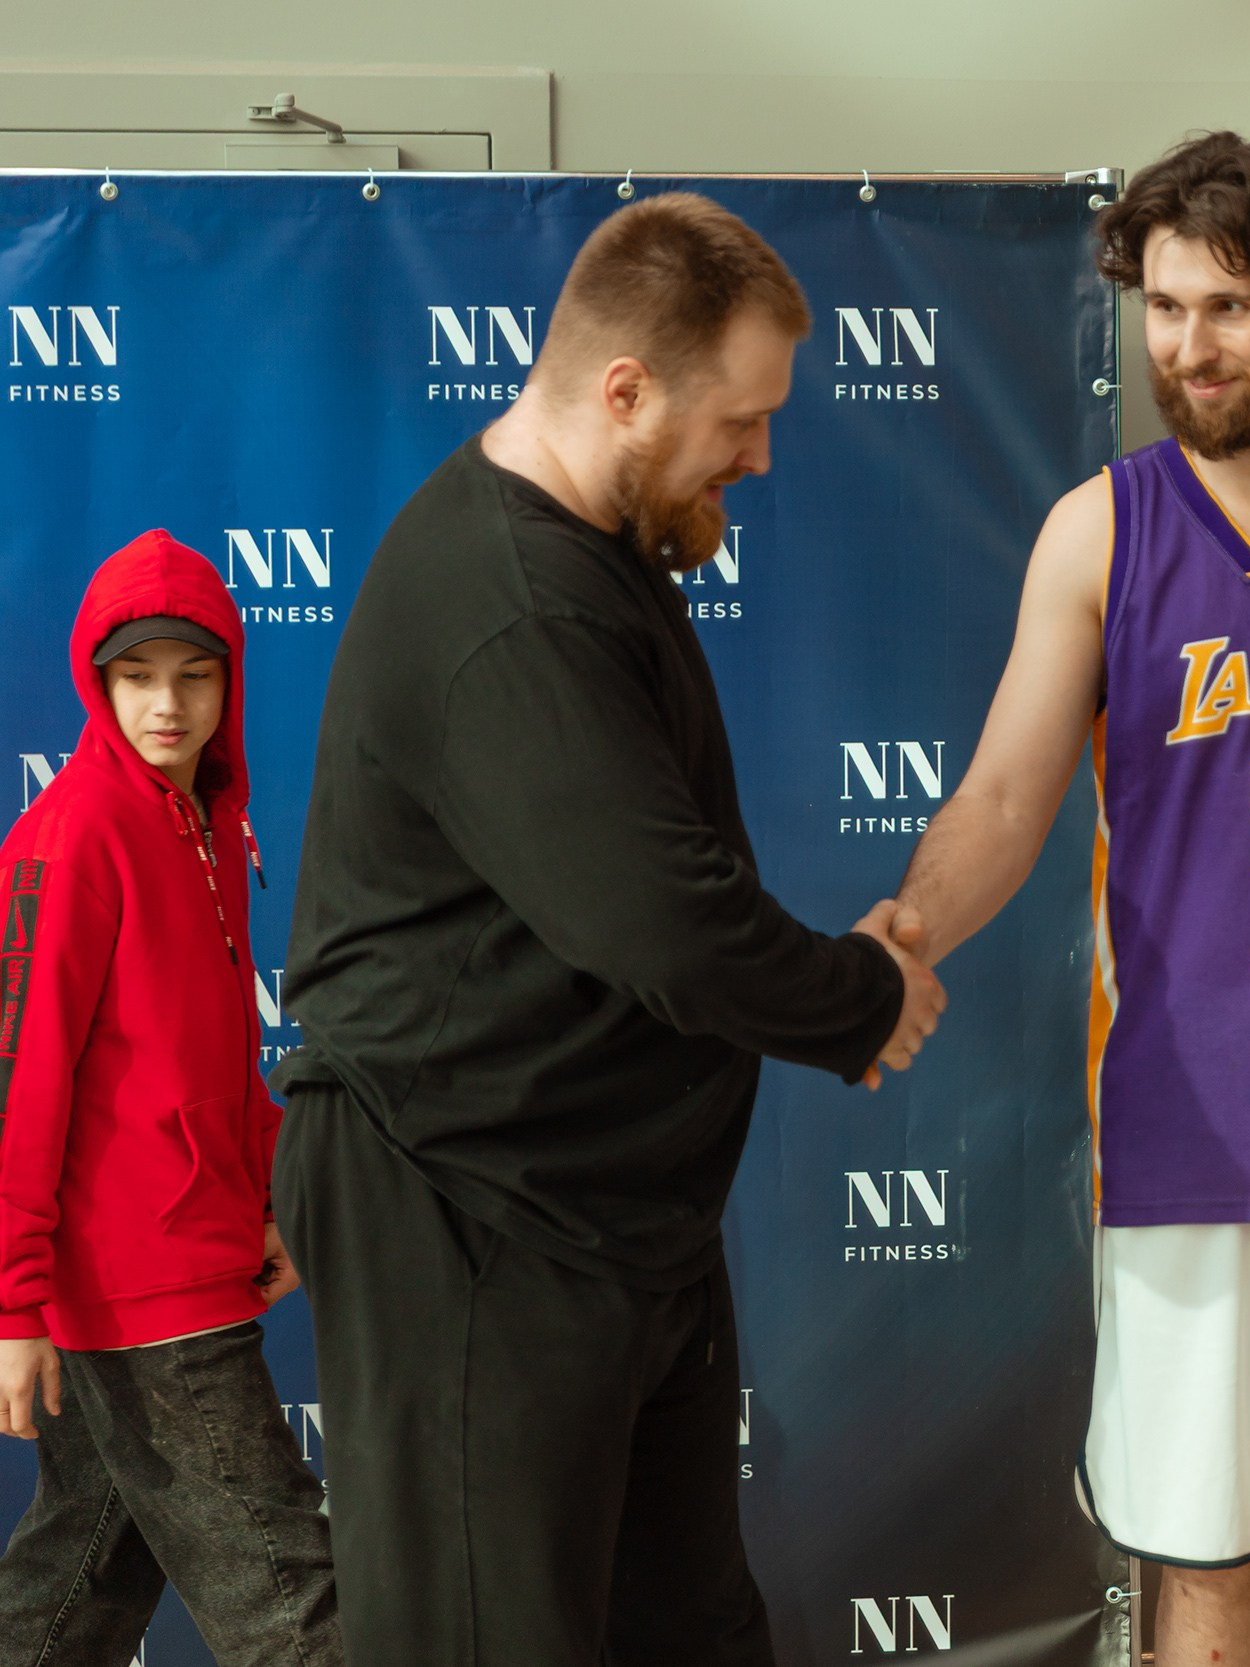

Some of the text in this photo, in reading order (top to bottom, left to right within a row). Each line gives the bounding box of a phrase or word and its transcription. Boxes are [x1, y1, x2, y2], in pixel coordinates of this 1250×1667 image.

[9, 306, 120, 366] NN
[428, 306, 536, 365] NN
[835, 308, 939, 365] NN
[9, 385, 121, 401] FITNESS
[428, 384, 520, 400] FITNES
[835, 384, 940, 400] FITNESS
[224, 529, 334, 588] NN
[241, 606, 334, 623] ITNESS
[840, 741, 946, 799] NN
[840, 817, 928, 834] FITNES
[7, 959, 25, 996] AIR
[844, 1169, 950, 1229] NN
[844, 1243, 949, 1262] FITNESS
[850, 1595, 956, 1654] NN
